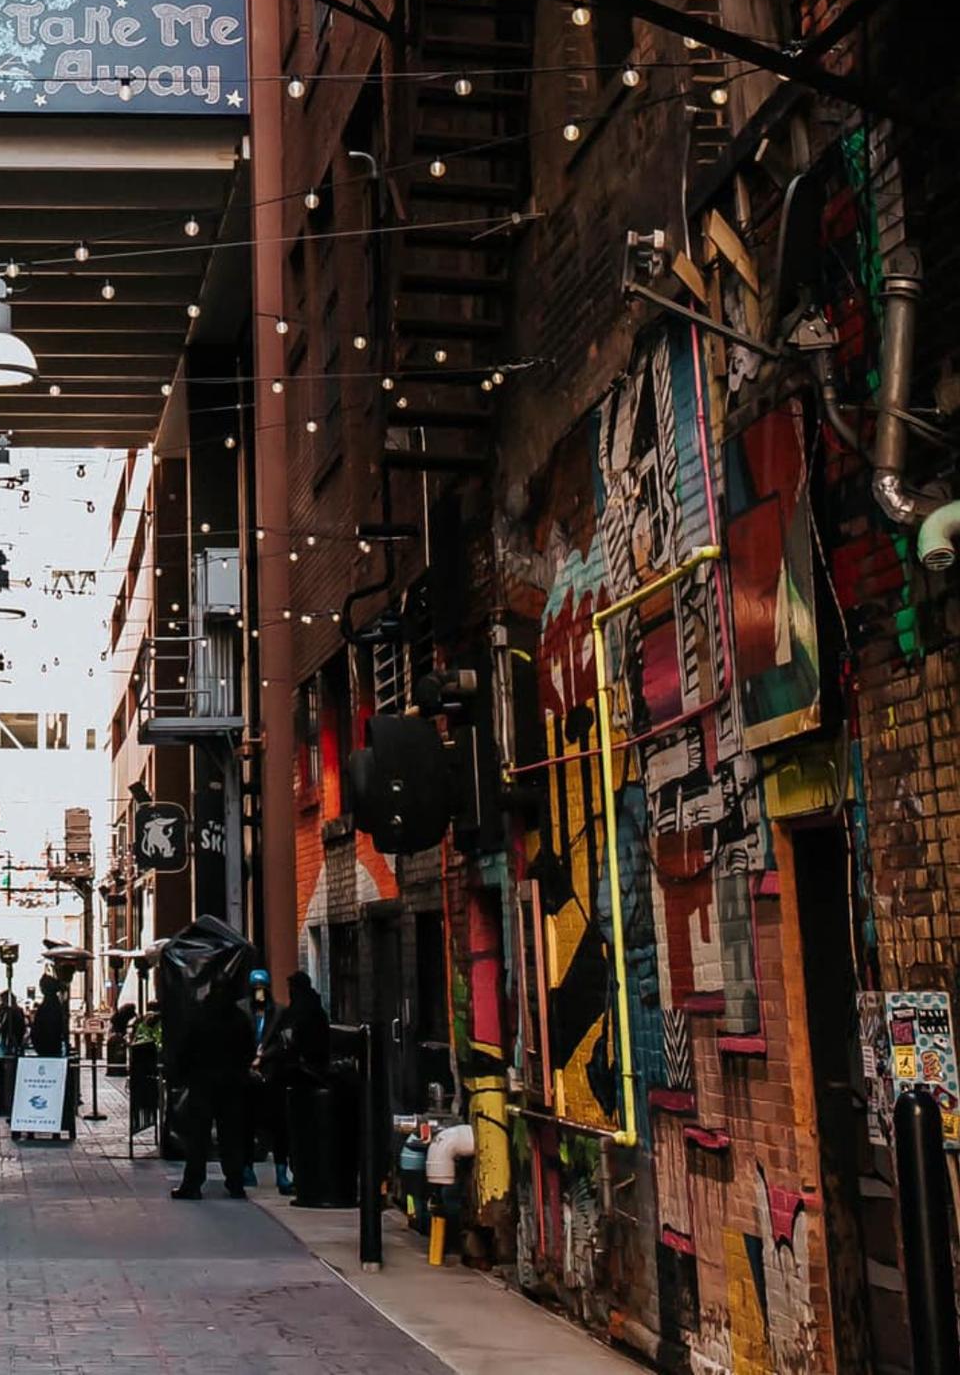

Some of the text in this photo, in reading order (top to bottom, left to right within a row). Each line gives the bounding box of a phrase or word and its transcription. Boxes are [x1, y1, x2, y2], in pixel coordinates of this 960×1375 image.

[2, 2, 244, 47] Take Me
[43, 49, 222, 105] Away
